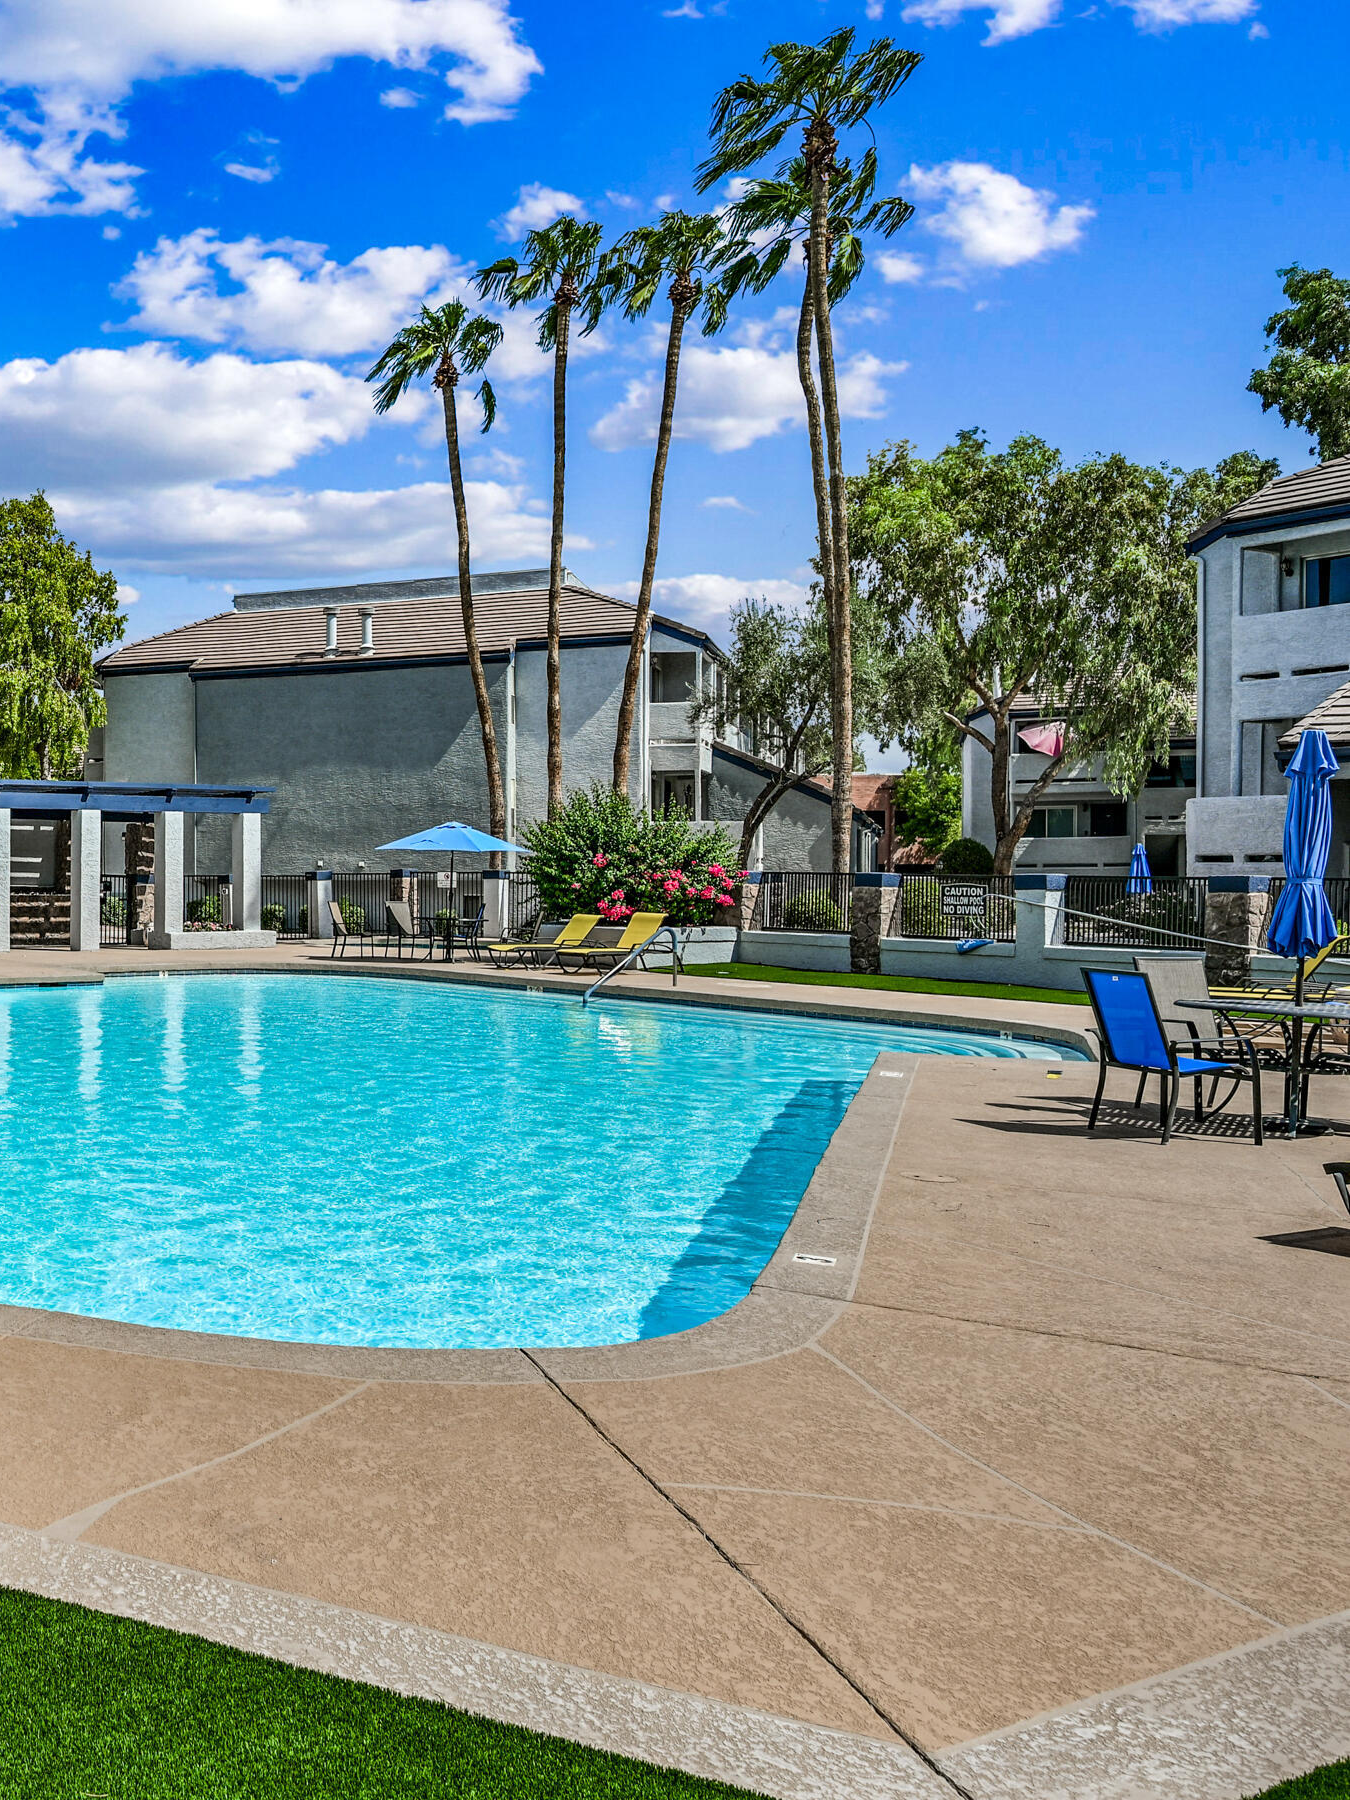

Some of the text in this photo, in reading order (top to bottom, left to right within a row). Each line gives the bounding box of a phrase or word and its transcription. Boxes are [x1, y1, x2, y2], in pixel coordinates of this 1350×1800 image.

[944, 887, 984, 896] CAUTION
[943, 896, 984, 905] SHALLOW POOL
[943, 905, 985, 915] NO DIVING
